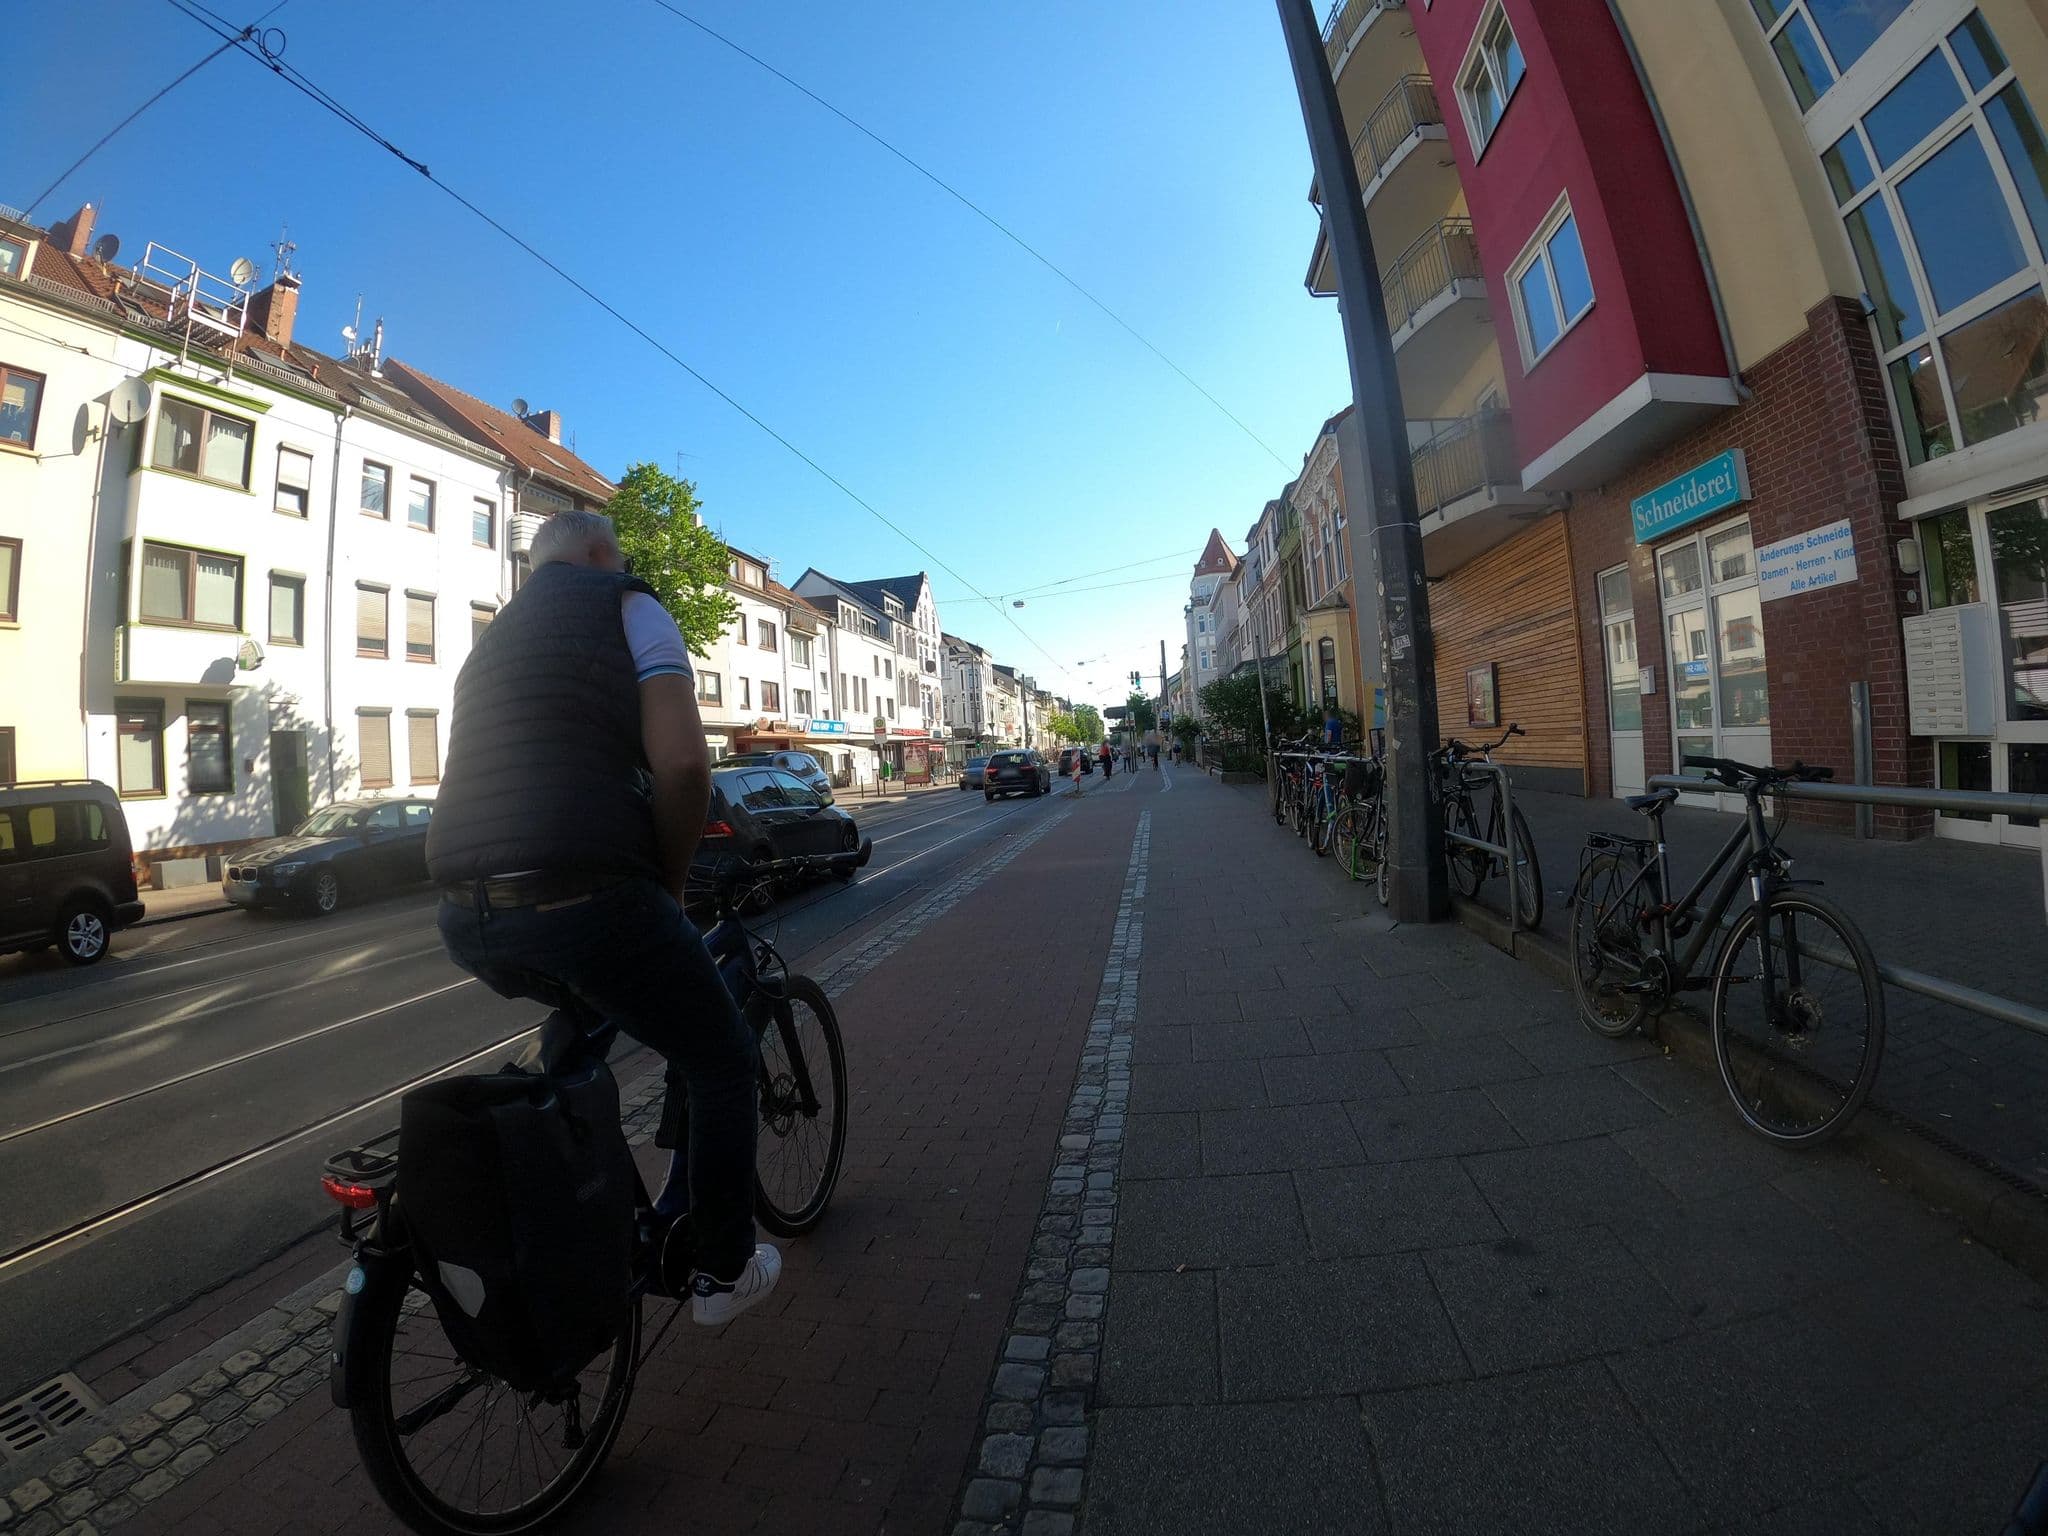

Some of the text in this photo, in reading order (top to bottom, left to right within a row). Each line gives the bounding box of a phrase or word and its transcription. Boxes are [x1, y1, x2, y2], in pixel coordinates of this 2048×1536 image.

[1635, 461, 1734, 531] Schneiderei
[1760, 542, 1805, 563] Änderungs
[1761, 566, 1789, 581] Damen
[1796, 556, 1826, 571] Herren
[1790, 569, 1837, 592] Alle Artikel
